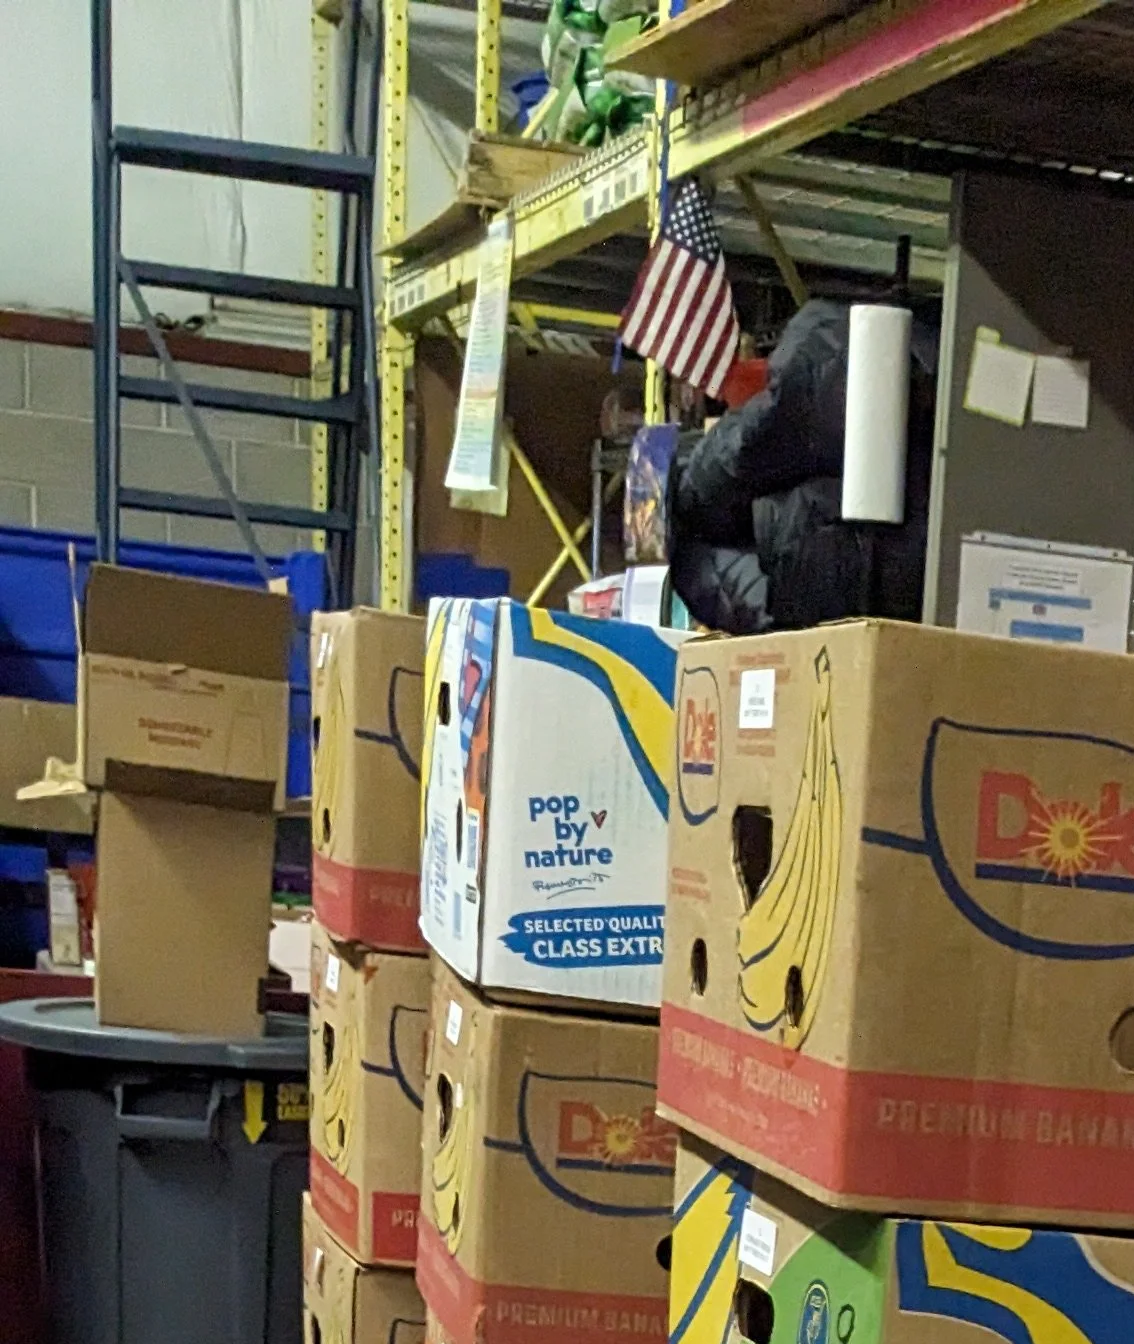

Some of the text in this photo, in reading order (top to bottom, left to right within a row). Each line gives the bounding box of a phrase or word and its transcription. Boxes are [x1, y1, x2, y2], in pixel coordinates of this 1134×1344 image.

[529, 795, 580, 822] pop
[554, 816, 588, 847] by
[524, 843, 613, 868] nature
[524, 915, 664, 934] SELECTED QUALIT
[533, 936, 664, 958] CLASS EXTR
[876, 1099, 1025, 1142] PREMIUM
[496, 1301, 669, 1335] PREMIUM BANA
